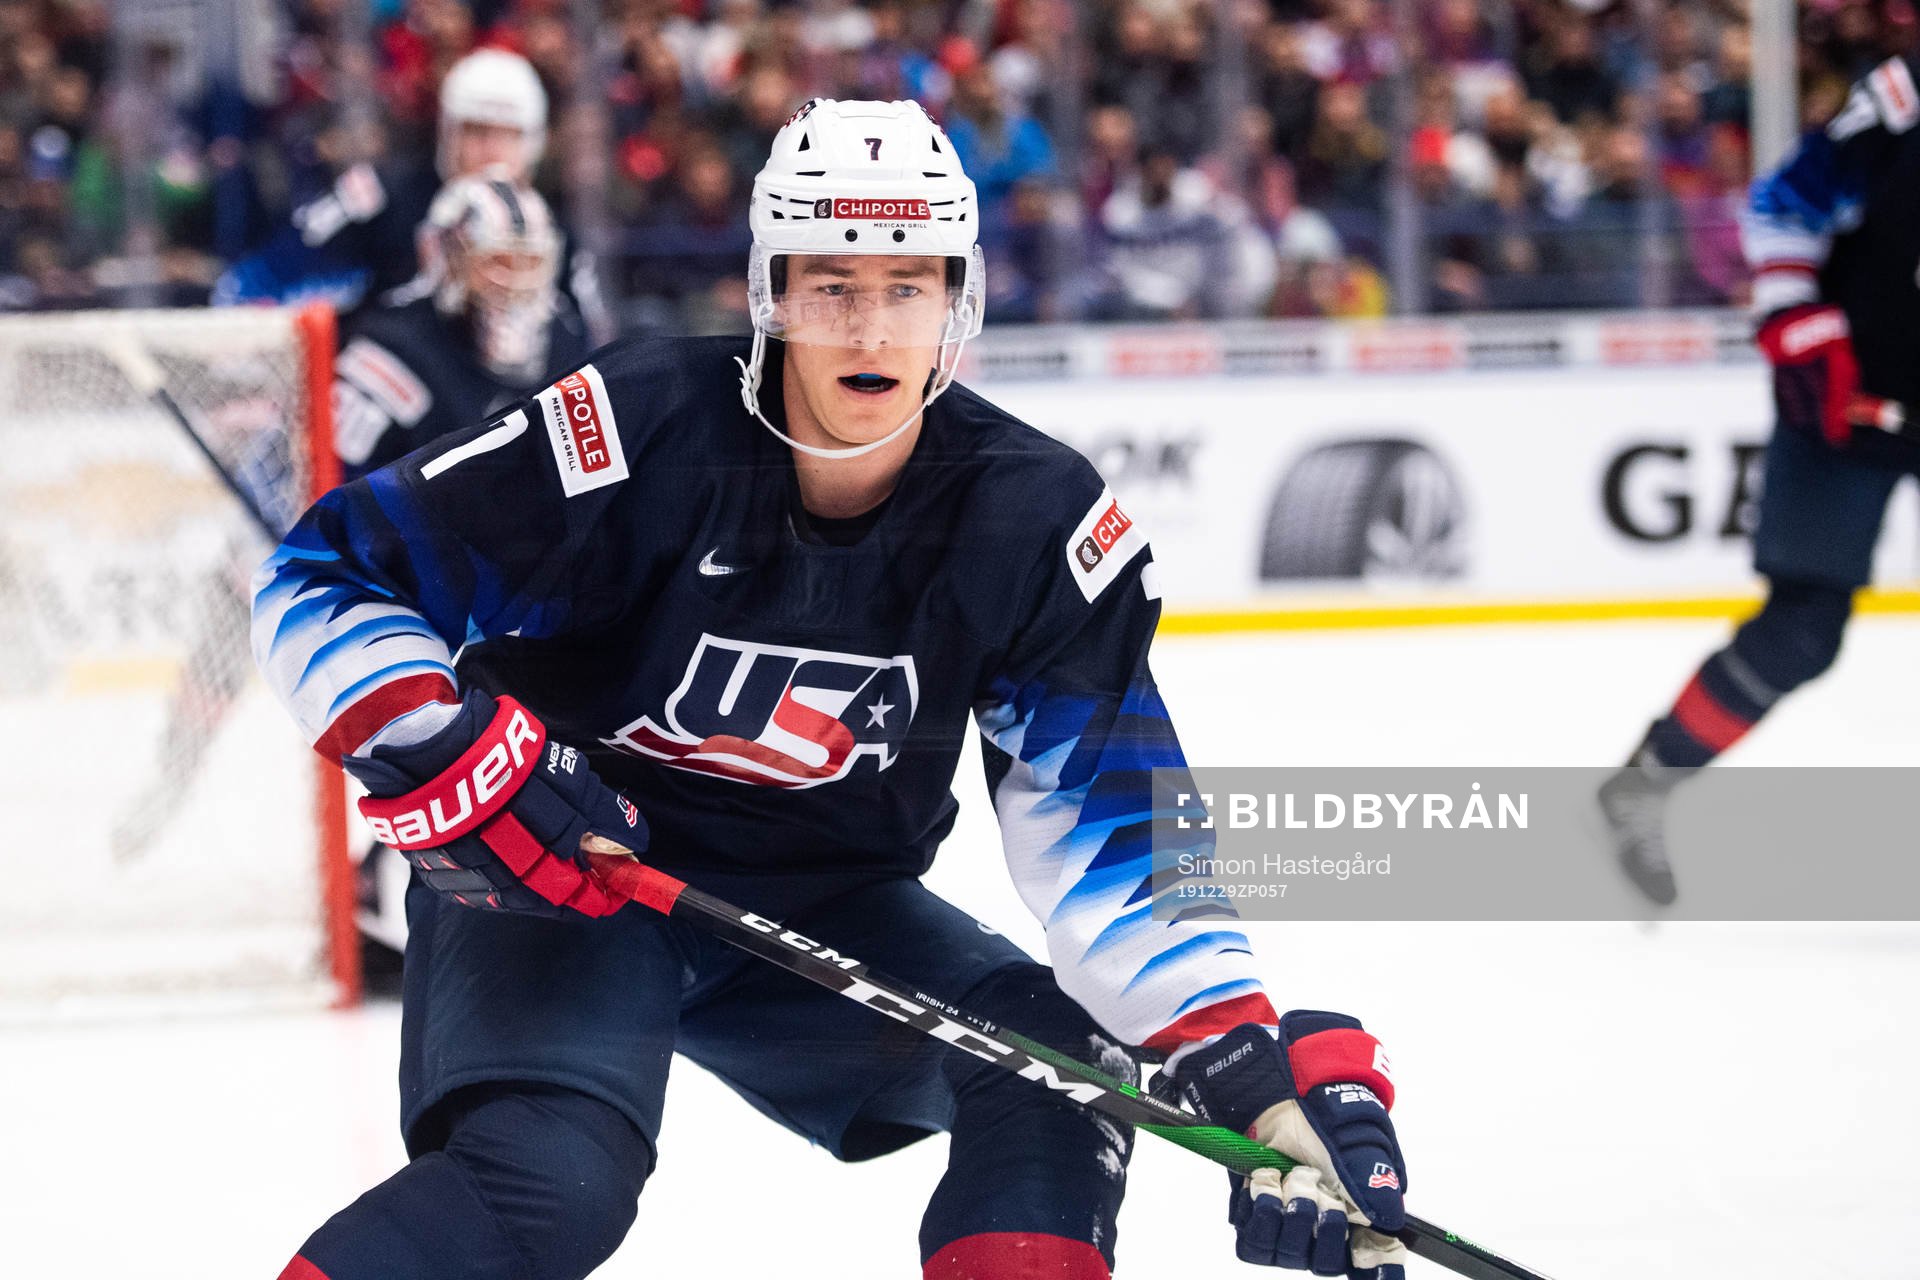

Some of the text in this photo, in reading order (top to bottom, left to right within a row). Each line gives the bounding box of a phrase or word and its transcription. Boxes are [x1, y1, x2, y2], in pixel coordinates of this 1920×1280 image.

[864, 137, 883, 161] 7
[837, 202, 928, 216] CHIPOTLE
[420, 408, 529, 481] 7
[551, 397, 577, 472] MEXICAN GRILL
[664, 632, 919, 787] USA
[740, 911, 861, 970] CCM
[915, 991, 959, 1017] IRISH 24
[839, 975, 1107, 1105] CCM
